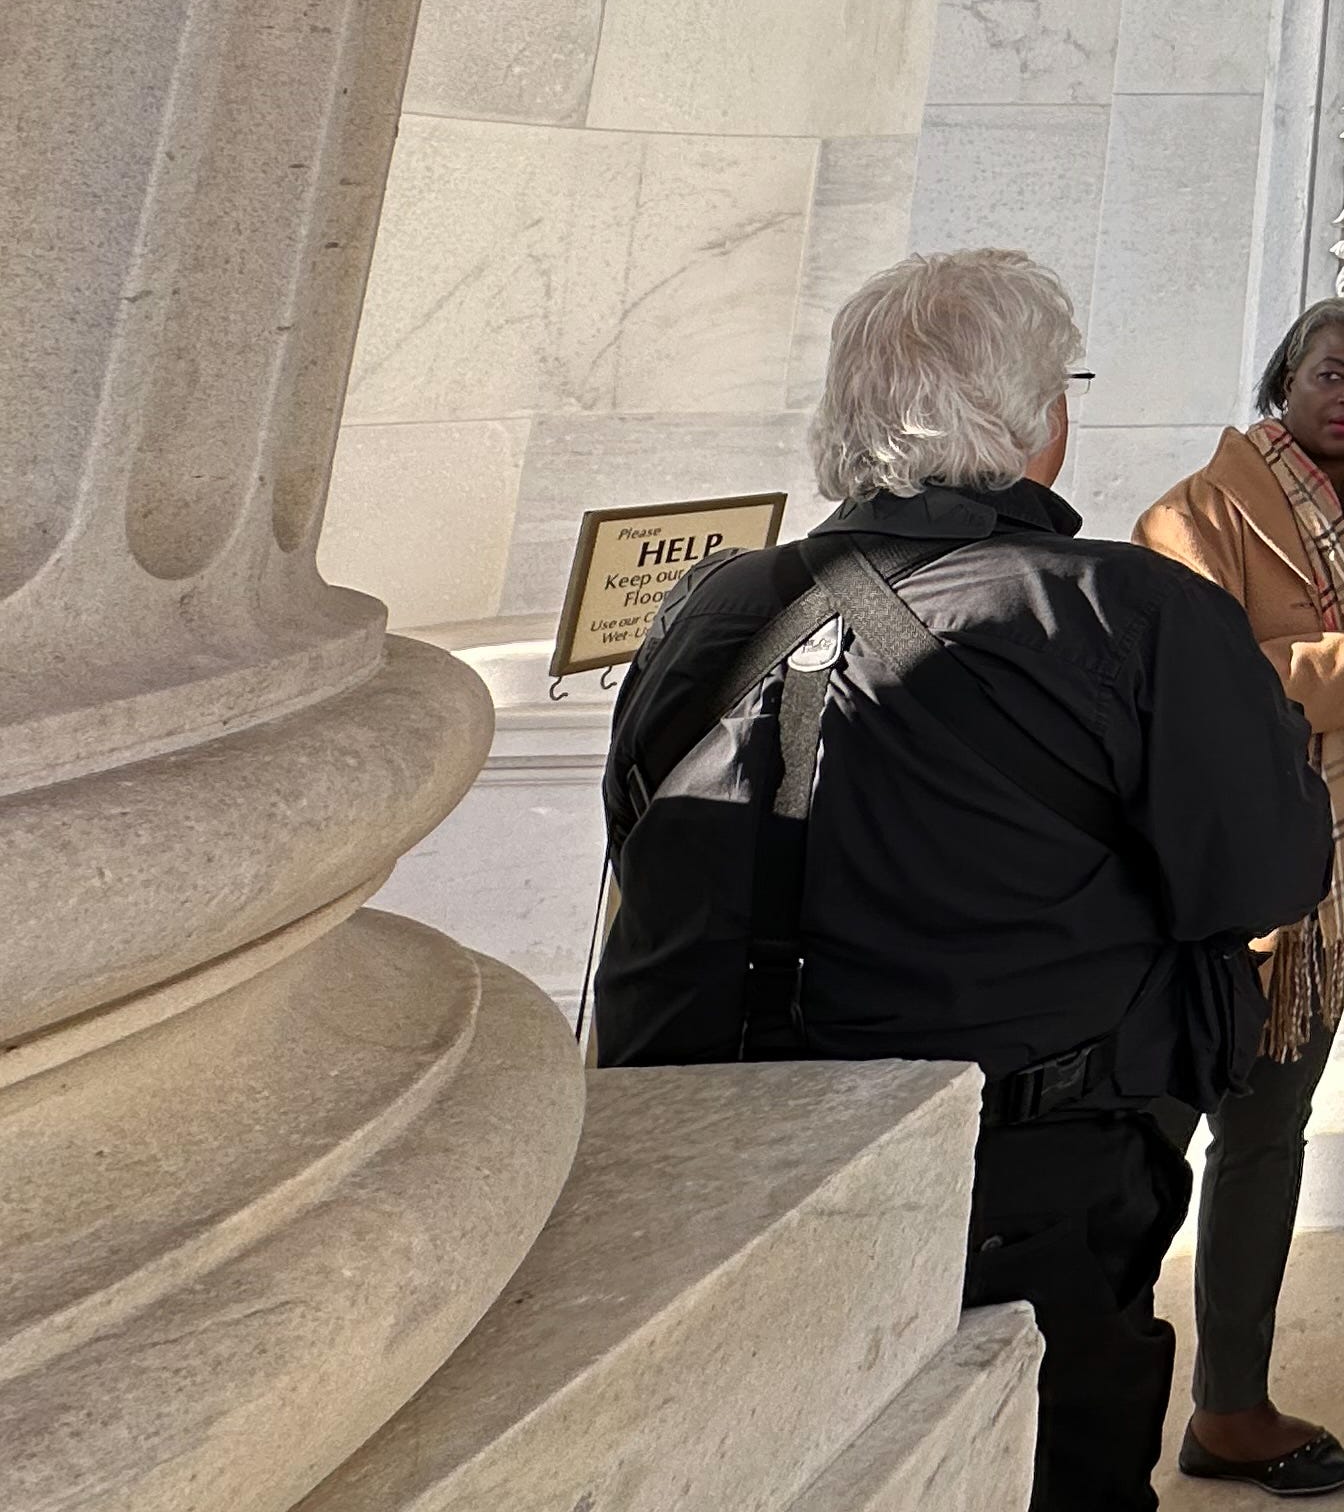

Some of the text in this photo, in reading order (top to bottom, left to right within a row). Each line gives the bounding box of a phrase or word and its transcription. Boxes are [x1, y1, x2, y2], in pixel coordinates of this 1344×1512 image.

[617, 527, 662, 540] Please
[637, 533, 724, 567] HELP
[604, 569, 685, 590] Keep our
[624, 590, 664, 607] Floo
[590, 619, 617, 632] Use
[618, 616, 641, 627] our
